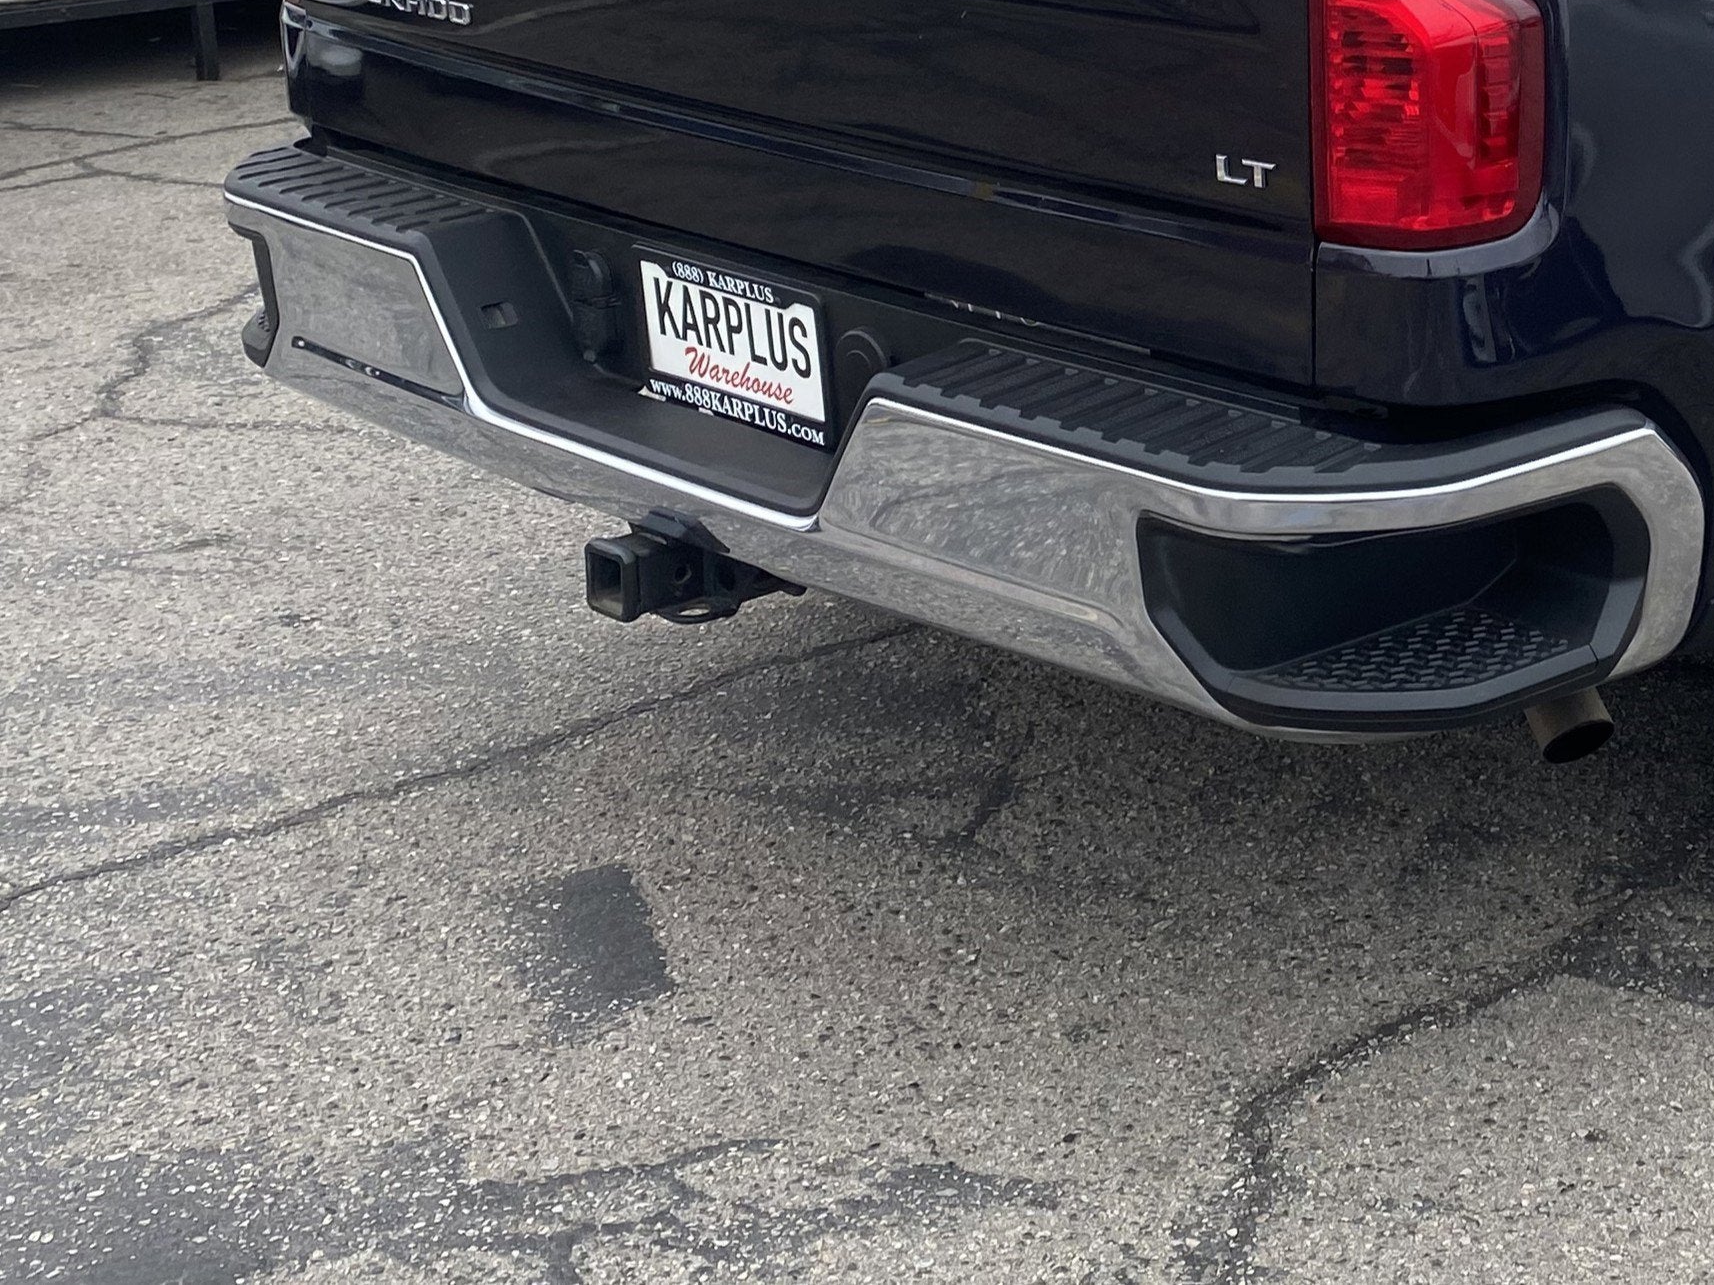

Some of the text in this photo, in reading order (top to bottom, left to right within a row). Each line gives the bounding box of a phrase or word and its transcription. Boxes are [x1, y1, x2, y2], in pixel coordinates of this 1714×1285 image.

[1216, 154, 1277, 188] LT
[672, 260, 774, 304] (888) KARPLUS
[653, 276, 812, 379] KARPLUS
[684, 346, 794, 405] Warehouse
